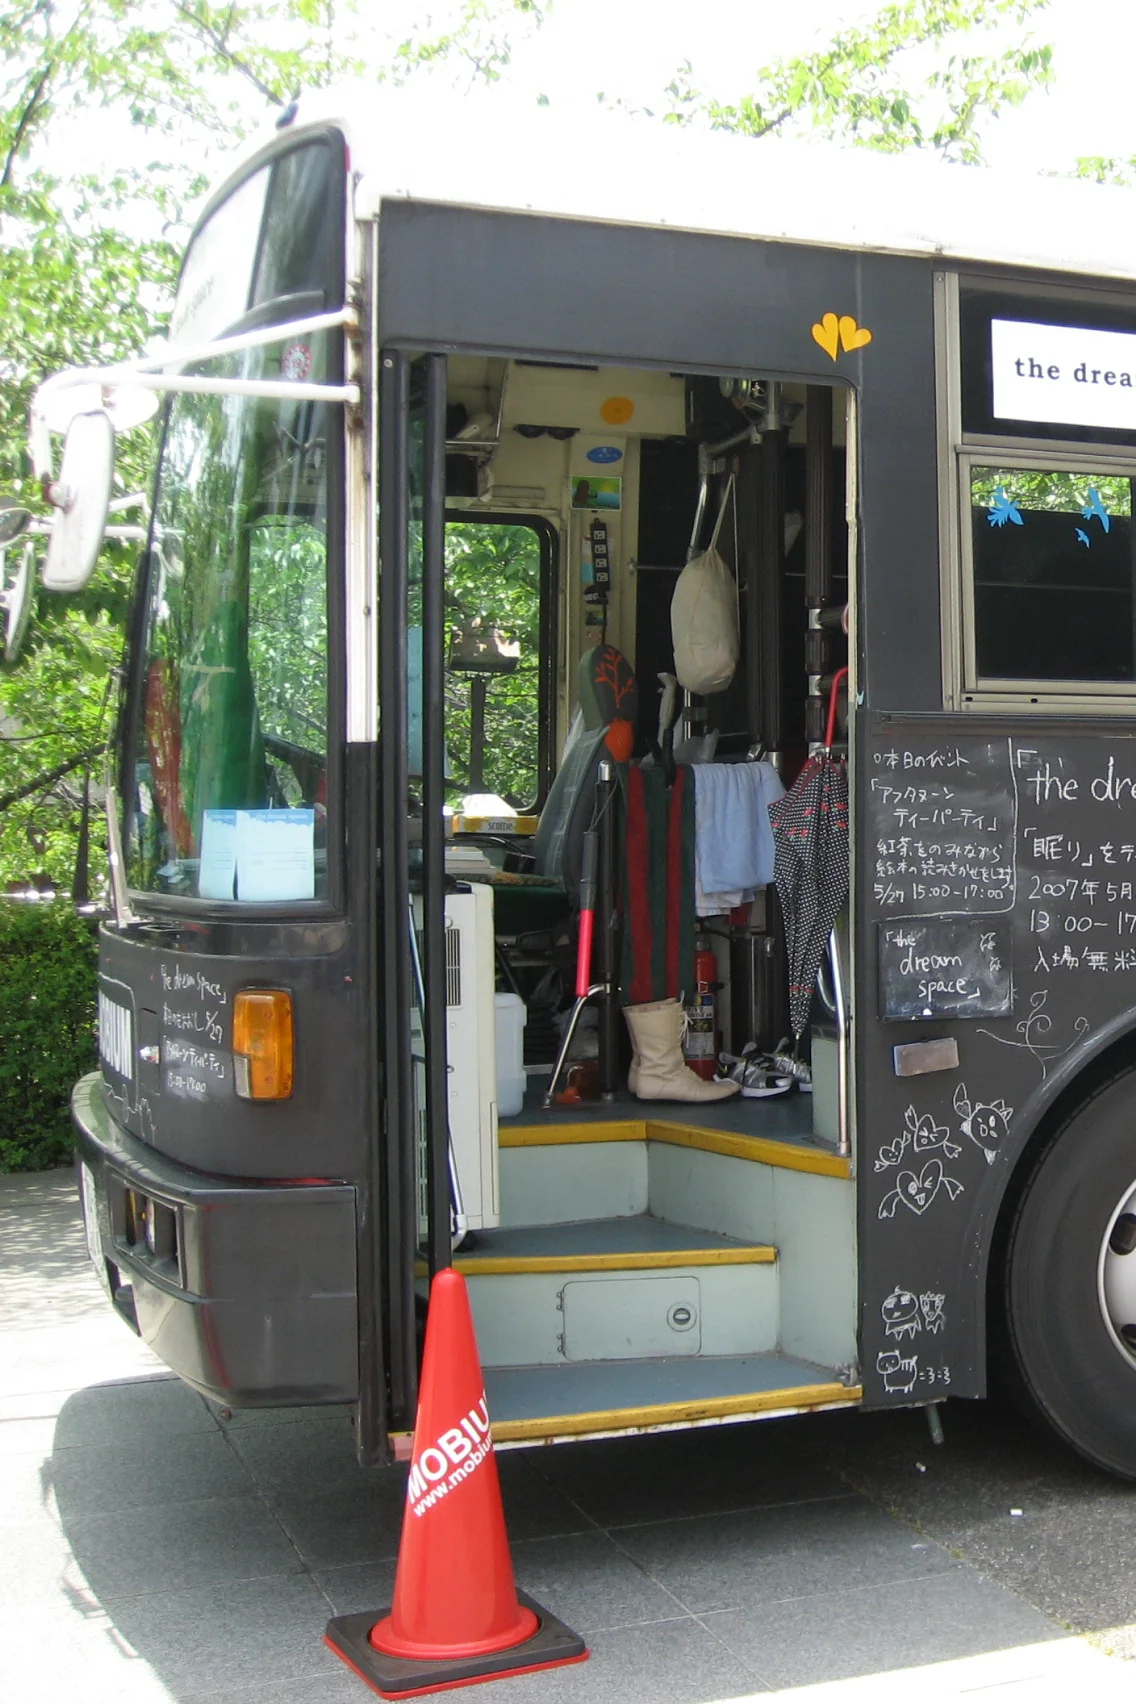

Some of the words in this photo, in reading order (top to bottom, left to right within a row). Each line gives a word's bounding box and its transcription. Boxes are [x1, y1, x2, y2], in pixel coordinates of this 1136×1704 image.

[1014, 357, 1060, 380] the
[872, 882, 905, 906] 5/27
[900, 946, 963, 975] dream
[407, 1386, 492, 1505] MOBIU
